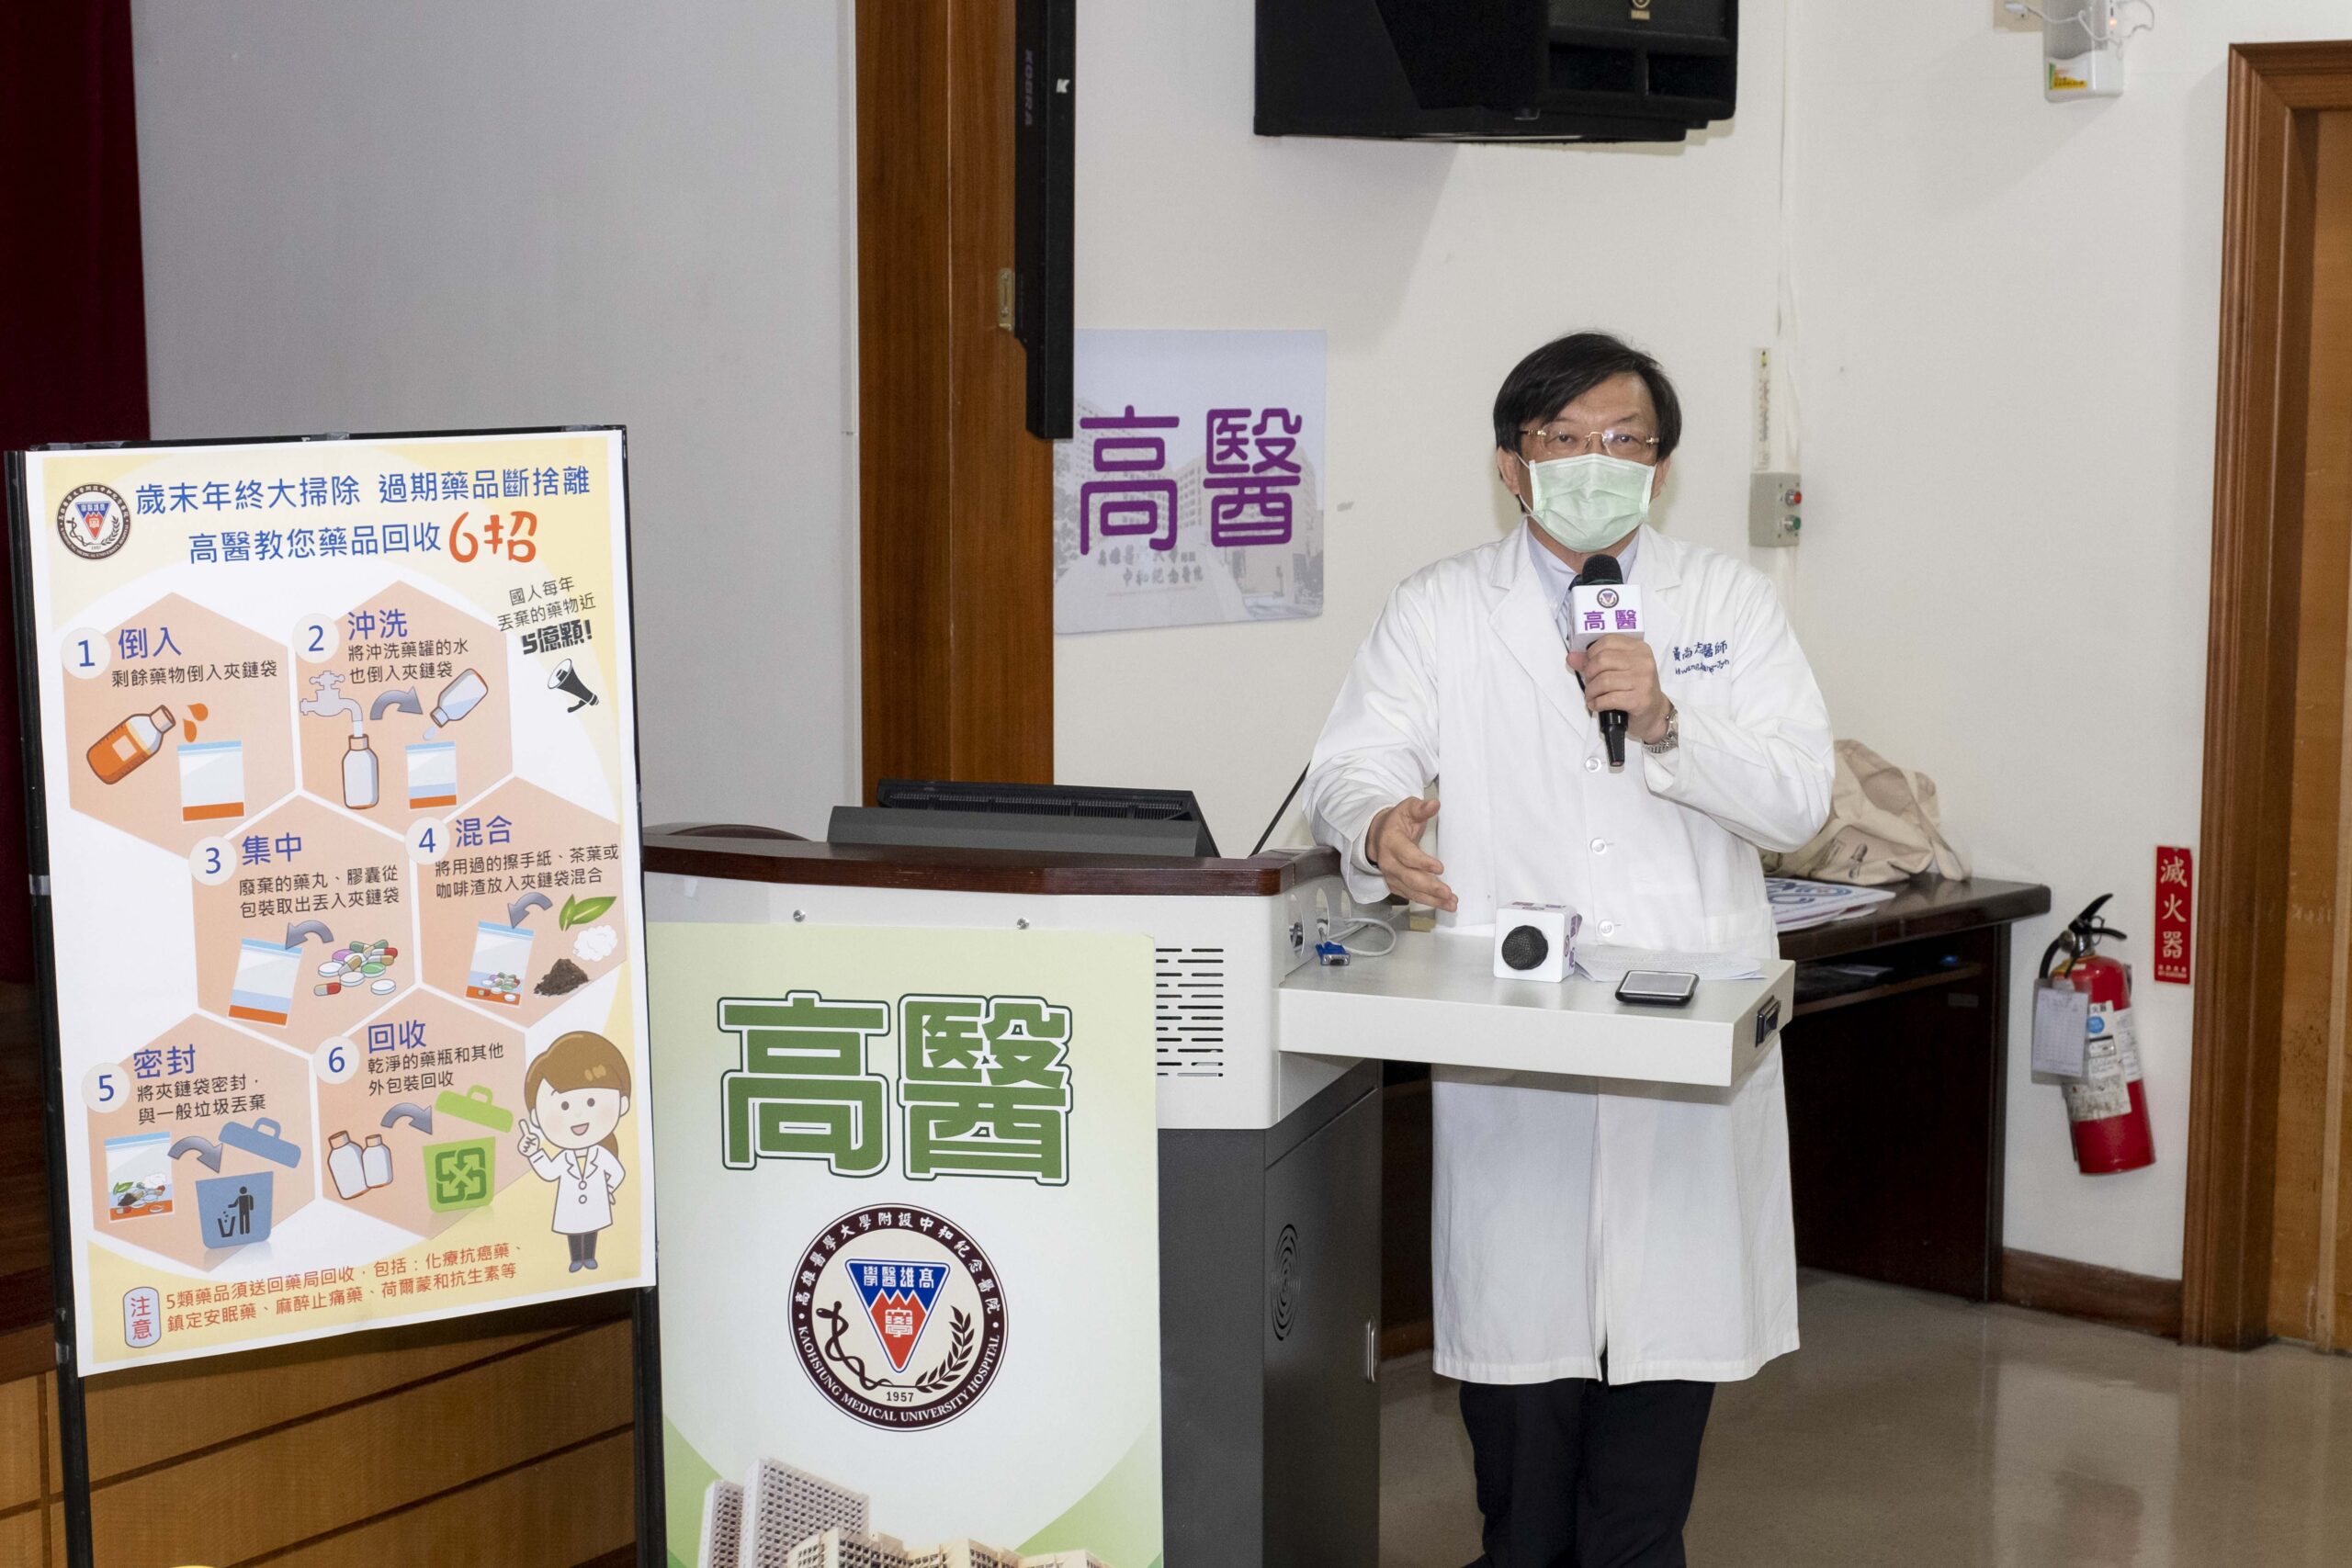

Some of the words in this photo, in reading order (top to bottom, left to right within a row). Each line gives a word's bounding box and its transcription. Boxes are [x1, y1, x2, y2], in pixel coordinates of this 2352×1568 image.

[135, 475, 361, 514] 歲末年終大掃除
[379, 466, 590, 503] 過期藥品斷捨離
[1080, 404, 1303, 556] 高醫
[509, 576, 575, 605] 國人每年
[347, 608, 408, 640] 沖洗
[497, 592, 597, 632] 丟棄的藥物近
[1583, 609, 1637, 631] 高醫
[77, 639, 96, 667] 1
[118, 626, 182, 660] 倒入
[308, 625, 324, 652] 2
[348, 637, 469, 662] 將沖洗藥罐的水
[111, 660, 277, 688] 剩餘藥物倒入夾鏈袋
[349, 660, 453, 684] 也倒入夾鏈袋
[418, 827, 436, 853] 4
[456, 815, 513, 848] 混合
[205, 847, 221, 874] 3
[242, 832, 302, 866] 集中
[435, 866, 603, 899] 咖啡渣放入夾鏈袋混合
[240, 886, 400, 919] 包裝取出丟入夾鏈袋
[2159, 856, 2188, 960] 滅火器
[368, 1020, 426, 1054] 回收
[133, 1043, 196, 1079] 密封
[328, 1046, 345, 1073] 6
[368, 1042, 504, 1074] 乾淨的藥瓶和其他
[98, 1074, 115, 1101] 5
[368, 1070, 454, 1097] 外包裝回收
[718, 990, 1073, 1186] 高醫
[139, 1093, 266, 1125] 與一般垃圾丟棄
[130, 1296, 153, 1340] 注意
[797, 1325, 842, 1396] KAOHSIUNG
[842, 1392, 898, 1422] MEDICAL
[900, 1391, 970, 1422] UNIVERSITY
[969, 1335, 1001, 1396] HOSPITAL
[886, 1392, 914, 1403] 1957
